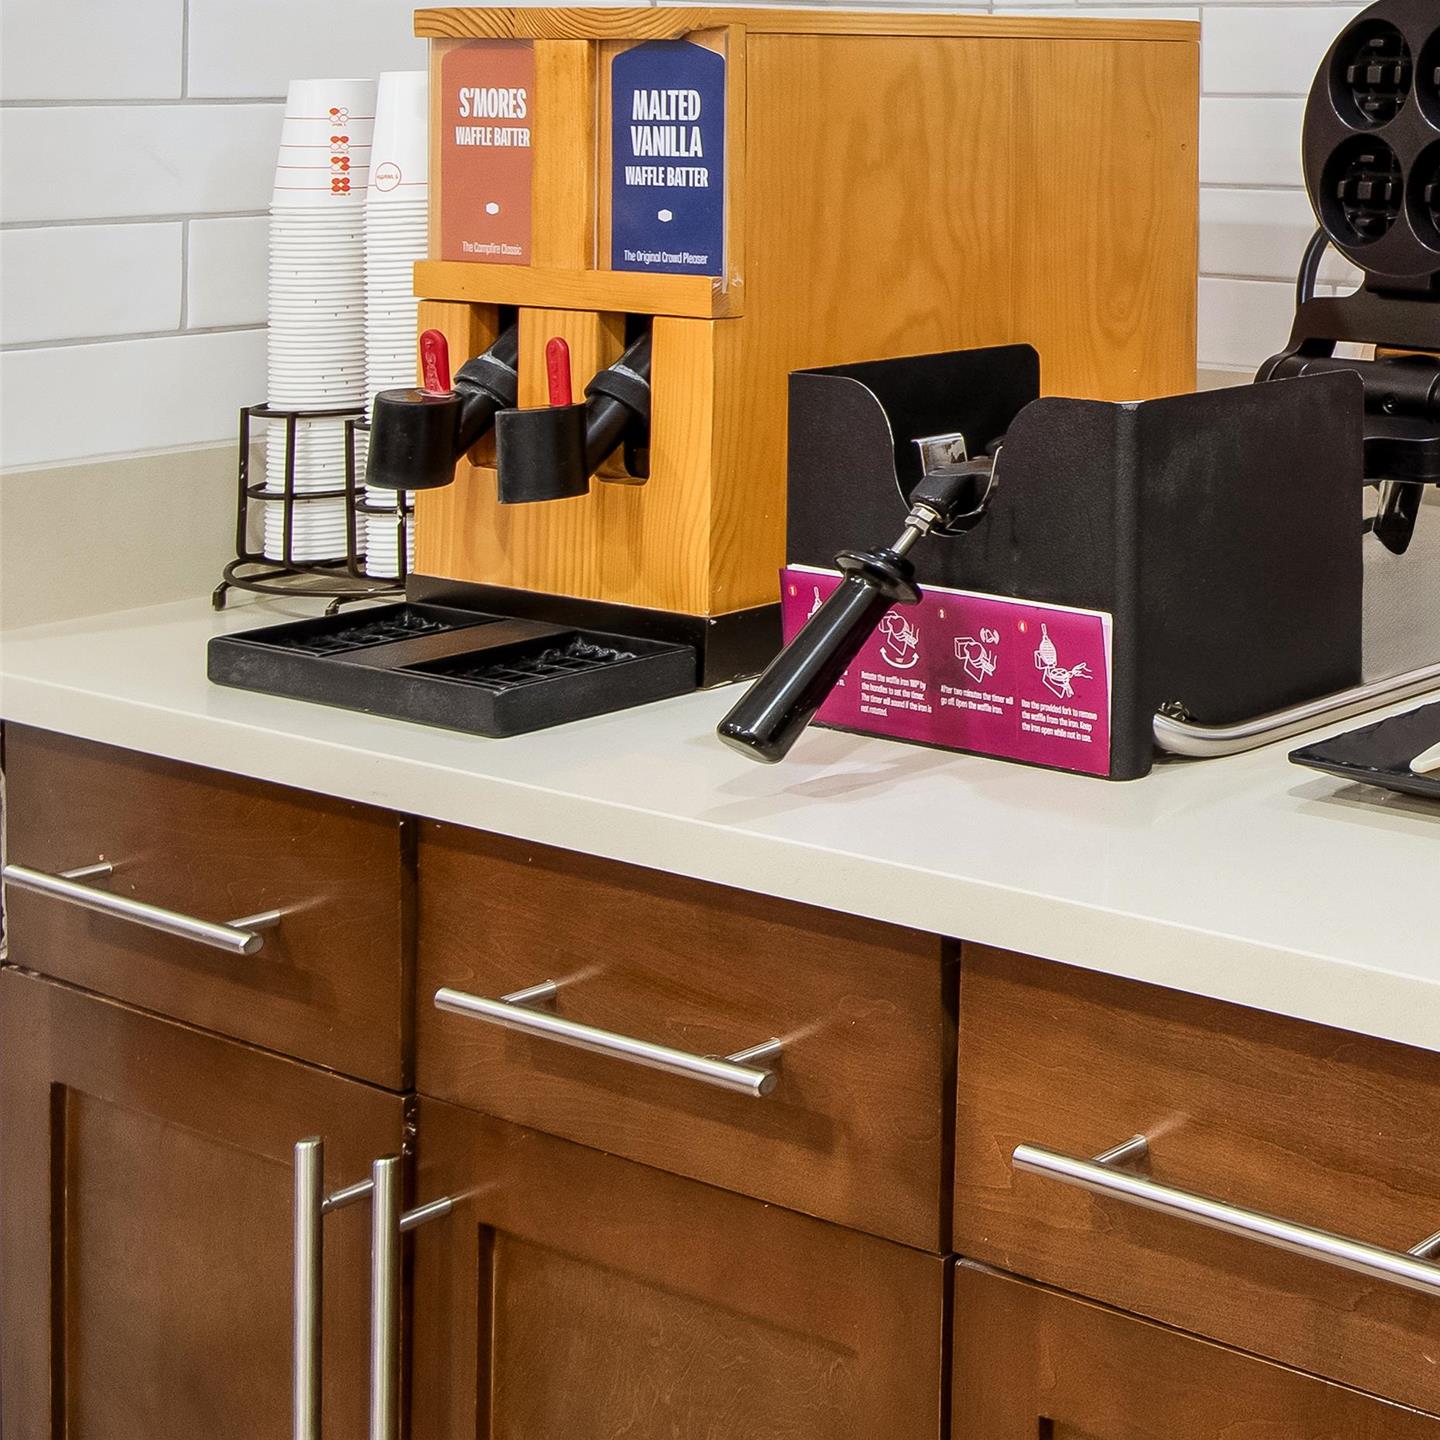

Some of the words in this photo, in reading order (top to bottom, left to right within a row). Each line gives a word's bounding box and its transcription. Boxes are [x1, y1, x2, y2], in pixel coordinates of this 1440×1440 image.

[632, 89, 700, 121] MALTED
[456, 127, 492, 146] WAFFLE
[494, 128, 530, 147] BATTER
[630, 126, 703, 157] VANILLA
[625, 166, 664, 186] WAFFLE
[666, 167, 708, 187] BATTER
[462, 241, 473, 252] The
[624, 250, 636, 261] The
[637, 250, 661, 264] Original
[662, 251, 682, 263] Crowd
[683, 252, 708, 264] Pleaser
